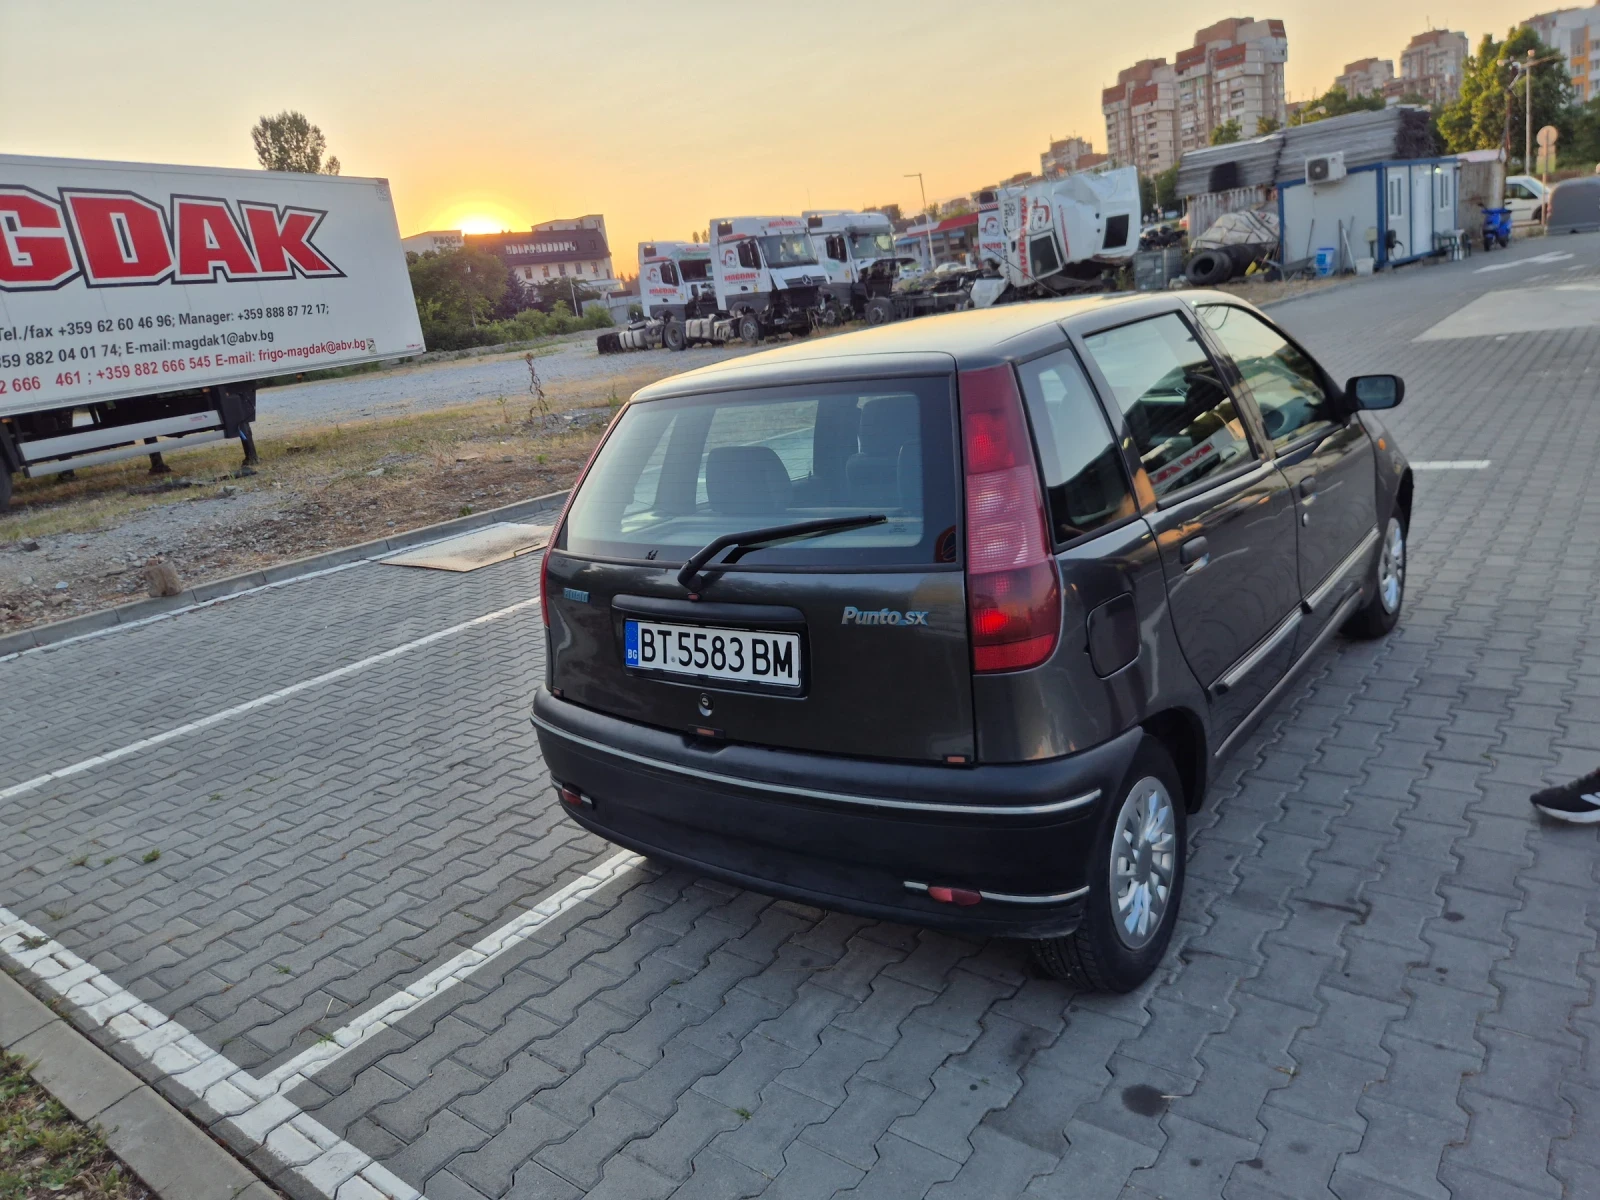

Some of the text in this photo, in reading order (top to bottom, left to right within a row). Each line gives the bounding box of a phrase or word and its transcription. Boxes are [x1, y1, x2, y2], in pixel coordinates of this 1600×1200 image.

[58, 321, 93, 336] +359
[97, 319, 114, 333] 62
[117, 317, 134, 331] 60
[138, 316, 153, 329] 46
[156, 314, 175, 328] 96;
[178, 312, 234, 325] Manager:
[237, 308, 263, 321] +359
[266, 306, 285, 319] 888
[287, 305, 299, 317] 87
[301, 304, 313, 316] 72
[316, 303, 329, 315] 17;
[12, 376, 41, 392] 666
[55, 370, 81, 387] 461
[96, 364, 131, 380] +359
[134, 361, 158, 377] 882
[162, 359, 185, 373] 666
[189, 355, 211, 370] 545
[215, 351, 256, 366] E-mail:
[258, 339, 366, 362] frigo-magdak@abv.bg
[25, 350, 54, 366] 882
[58, 347, 76, 362] 04
[80, 345, 96, 360] 01
[101, 343, 122, 357] 74;
[841, 606, 901, 625] Punto
[627, 649, 638, 660] BG
[641, 628, 793, 679] BT 5583 BM
